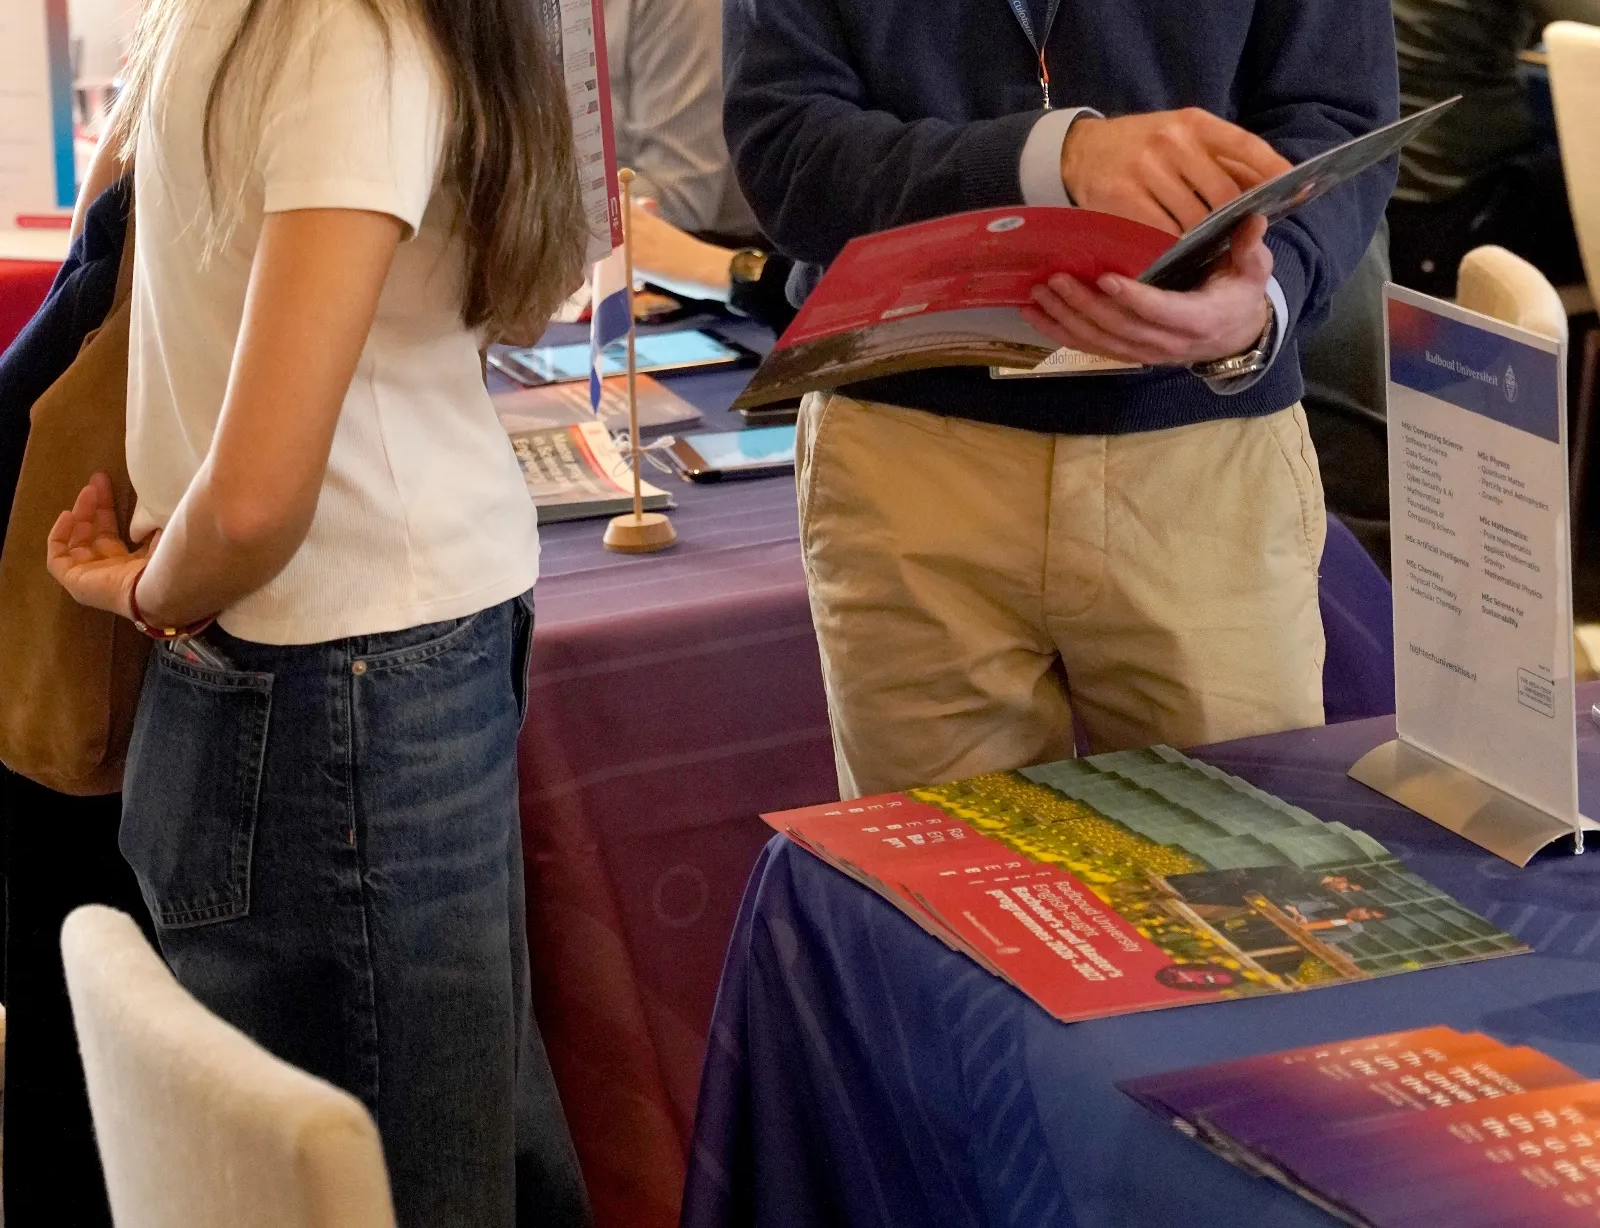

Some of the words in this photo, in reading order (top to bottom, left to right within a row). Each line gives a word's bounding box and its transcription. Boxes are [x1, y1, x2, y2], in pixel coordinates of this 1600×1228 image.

[1425, 350, 1456, 372] Radboud
[1456, 360, 1499, 387] Universiteit
[985, 889, 1054, 942] programmes
[1011, 885, 1064, 929] Bachelor's
[1056, 927, 1087, 945] and
[1075, 943, 1124, 979] Master's
[1032, 883, 1100, 938] English-taught
[1054, 880, 1098, 916] Radboud
[1092, 913, 1142, 952] University
